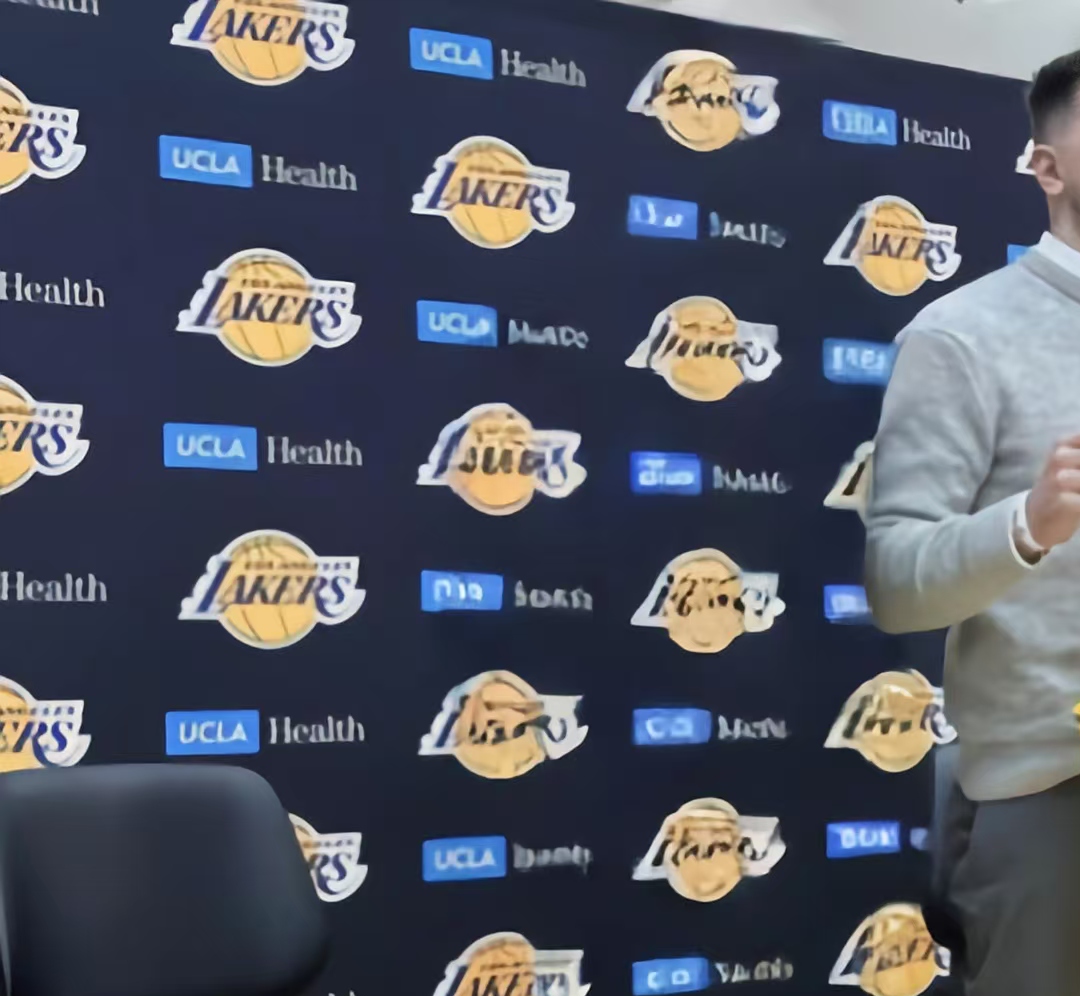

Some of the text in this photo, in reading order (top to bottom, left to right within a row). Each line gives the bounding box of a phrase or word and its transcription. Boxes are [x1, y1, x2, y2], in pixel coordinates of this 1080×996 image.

[421, 40, 587, 88] UCLA Health
[903, 117, 972, 150] Health
[172, 147, 358, 191] UCLA Health
[425, 160, 563, 226] LAKERS
[0, 271, 105, 308] Health
[195, 276, 350, 342] LAKERS
[176, 435, 363, 466] UCLA Health
[0, 571, 107, 602] Health
[196, 560, 353, 618] LAKERS
[179, 715, 365, 745] UCLA Health
[434, 848, 497, 871] UCLA
